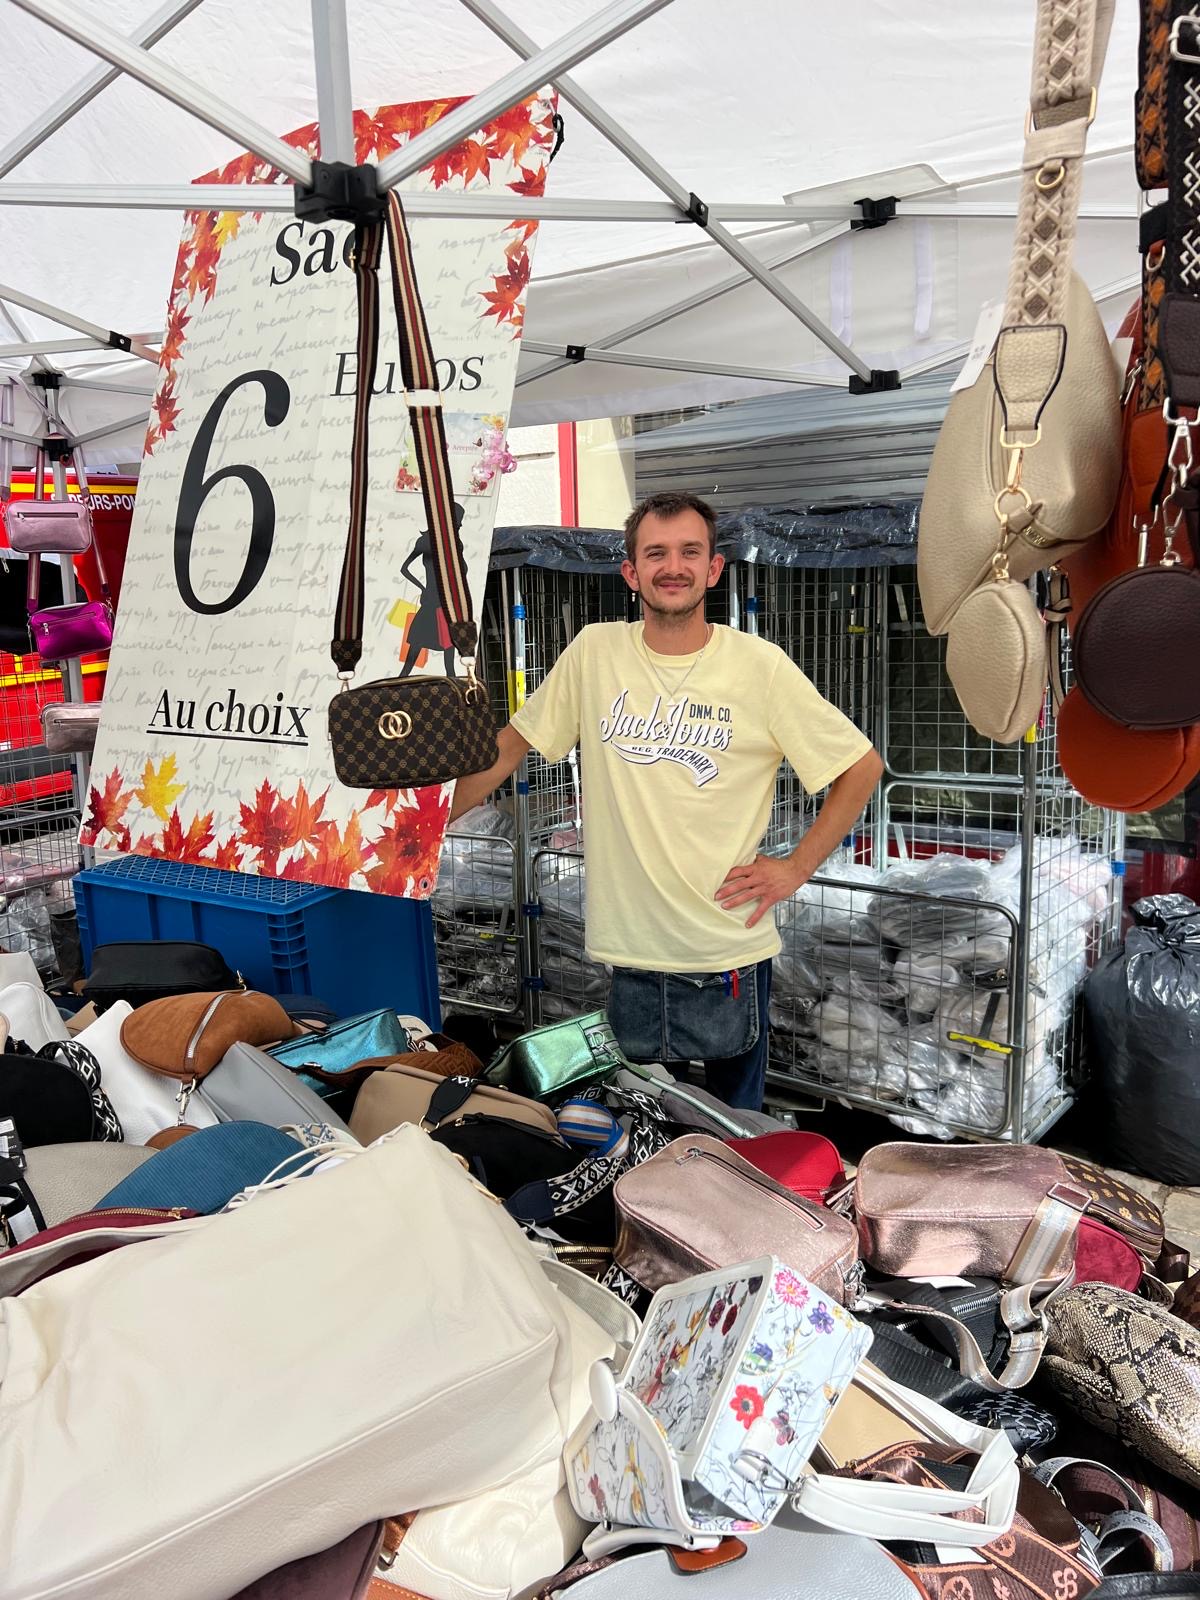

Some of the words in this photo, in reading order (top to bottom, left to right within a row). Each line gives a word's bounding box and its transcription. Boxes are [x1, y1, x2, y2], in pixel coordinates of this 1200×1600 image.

[330, 352, 484, 396] Euos
[174, 369, 291, 615] 6
[148, 689, 196, 730] Au
[205, 688, 311, 738] choix
[689, 703, 715, 720] DNM.
[718, 707, 732, 723] CO.
[656, 746, 714, 775] TRADEMARK
